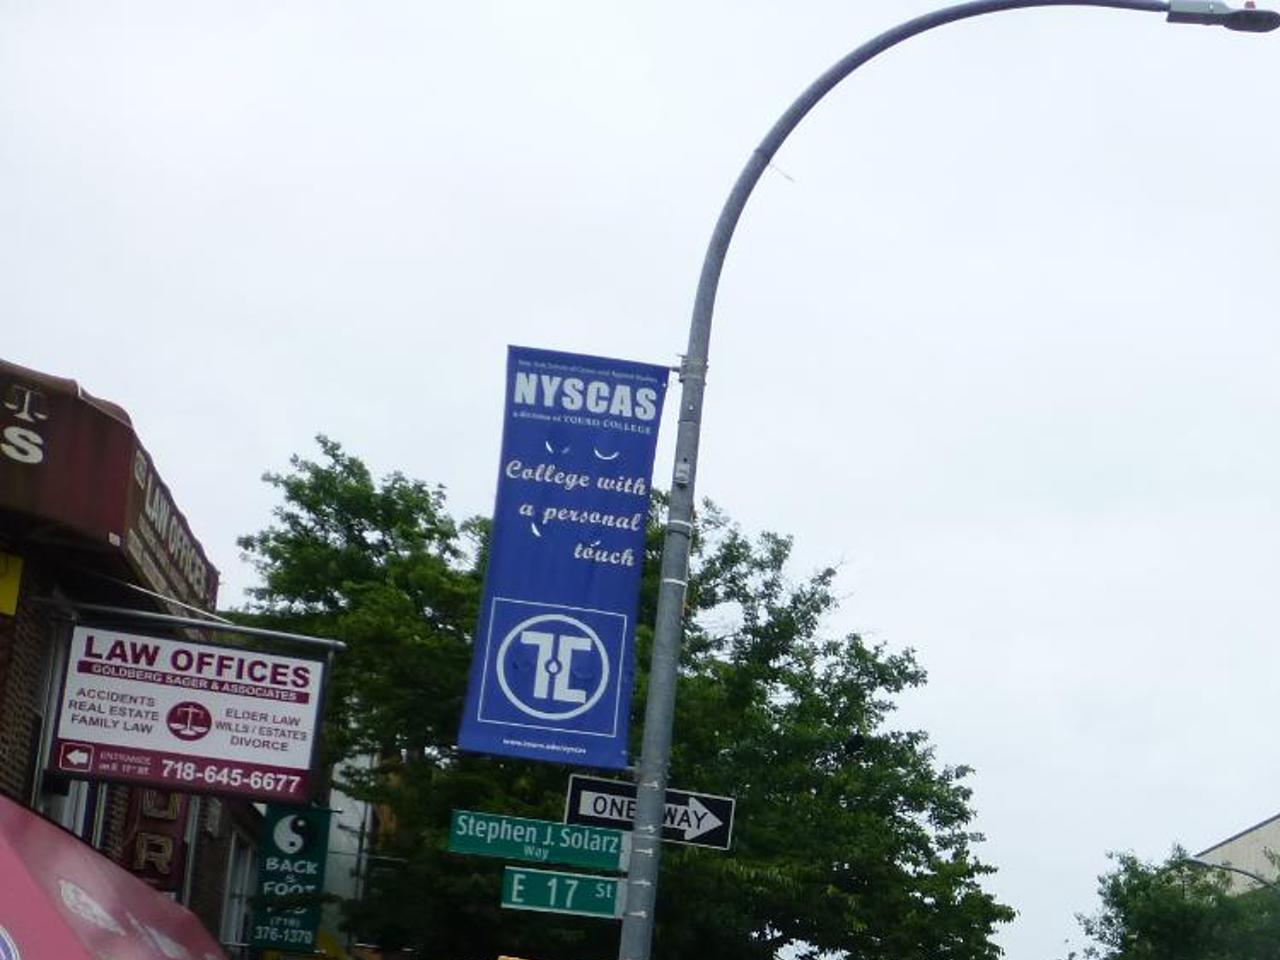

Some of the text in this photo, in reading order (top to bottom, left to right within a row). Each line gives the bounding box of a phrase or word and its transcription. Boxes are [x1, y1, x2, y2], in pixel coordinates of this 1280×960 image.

[514, 372, 658, 421] NYSCAS
[603, 418, 651, 435] COLLEGE
[506, 459, 647, 496] College with
[519, 502, 642, 532] a personal
[573, 542, 635, 566] touch
[84, 635, 311, 689] LAW OFFICES
[92, 663, 298, 701] GOLDBERG SAGER & ASSOCIATES
[76, 687, 156, 708] ACCIDENTS
[68, 699, 160, 722] REAL ESTATE
[225, 707, 302, 727] ELDER LAW
[71, 714, 154, 735] FAMILY LAW
[215, 720, 249, 735] WILLS
[258, 726, 308, 742] ESTATES
[229, 735, 289, 752] DIVORCE
[161, 759, 301, 793] 718-645-6677
[593, 796, 709, 830] ONE WAY
[456, 814, 620, 853] Stephen J. Solarz
[523, 845, 549, 861] Way
[265, 857, 319, 876] BACK
[511, 873, 613, 909] E 17 St
